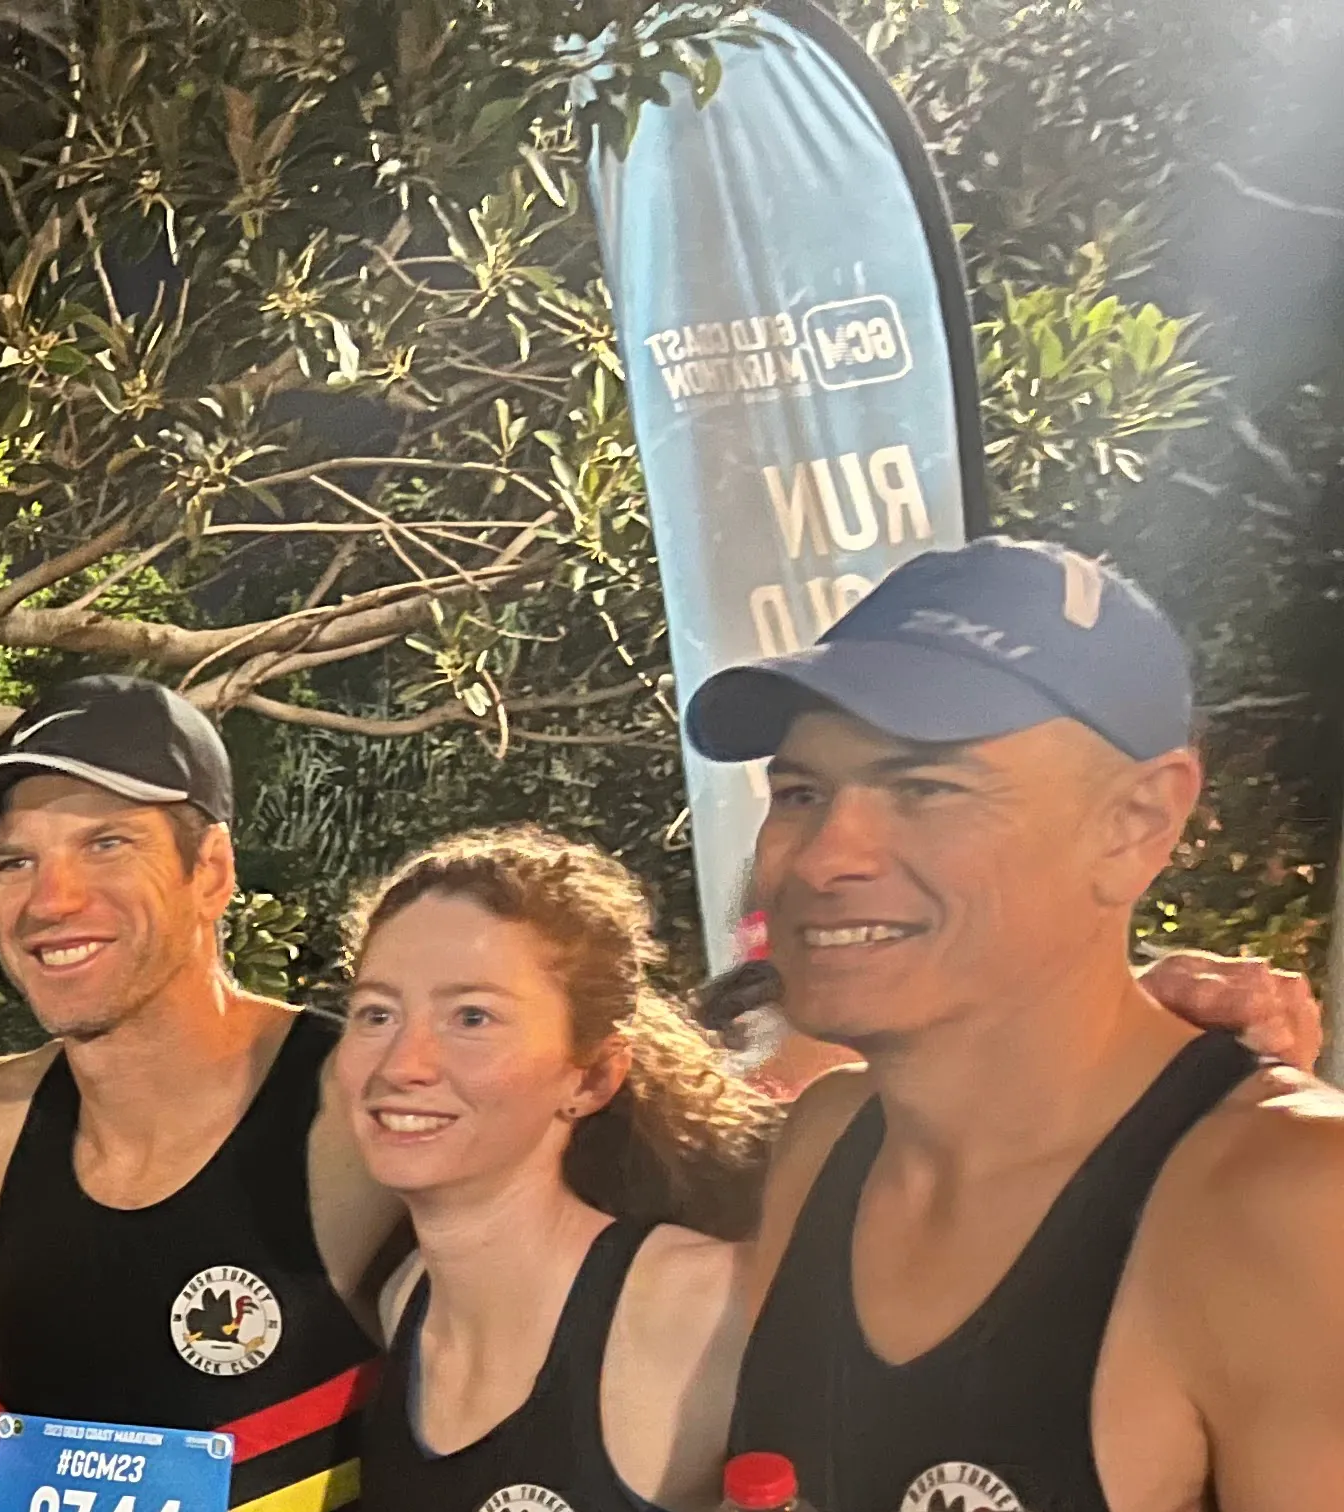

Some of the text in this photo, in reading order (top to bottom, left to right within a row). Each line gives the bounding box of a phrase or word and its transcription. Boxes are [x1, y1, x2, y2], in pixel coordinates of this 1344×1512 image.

[221, 1267, 274, 1302] TURKEY
[180, 1343, 221, 1375] TRACK
[55, 1448, 147, 1484] #GCM23
[960, 1463, 1021, 1512] TURKE
